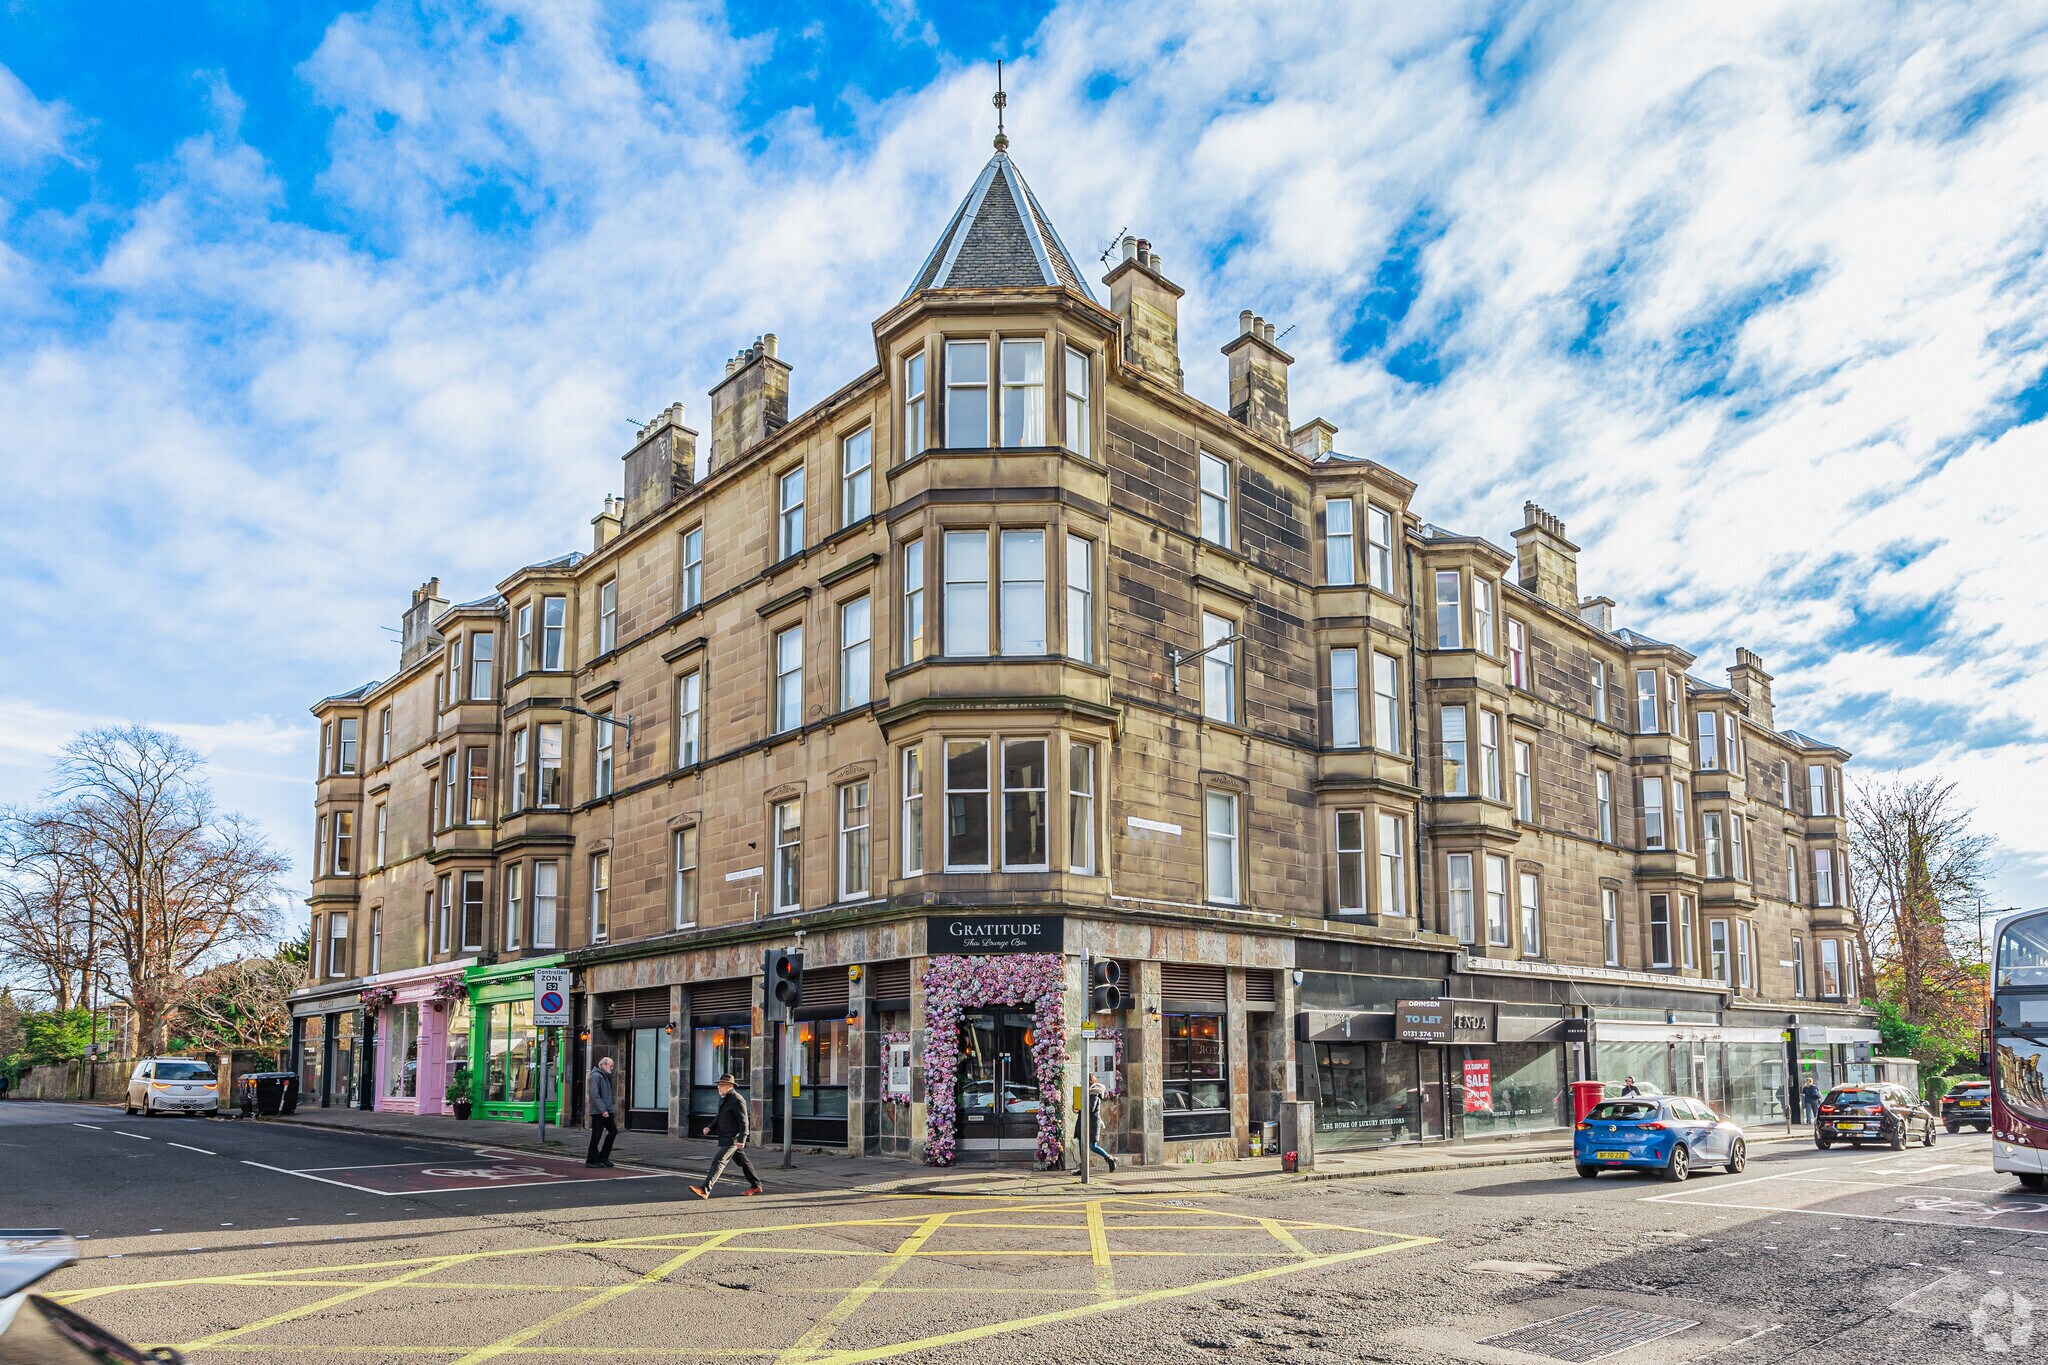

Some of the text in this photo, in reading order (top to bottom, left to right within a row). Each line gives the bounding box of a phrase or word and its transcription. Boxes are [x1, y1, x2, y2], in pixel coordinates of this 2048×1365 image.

[949, 922, 1041, 936] GRATITUDE
[963, 938, 1027, 949] Thai Lounge Bar
[1405, 1015, 1442, 1024] TO LET
[1466, 1074, 1489, 1088] SALE
[1334, 1121, 1350, 1129] HOME
